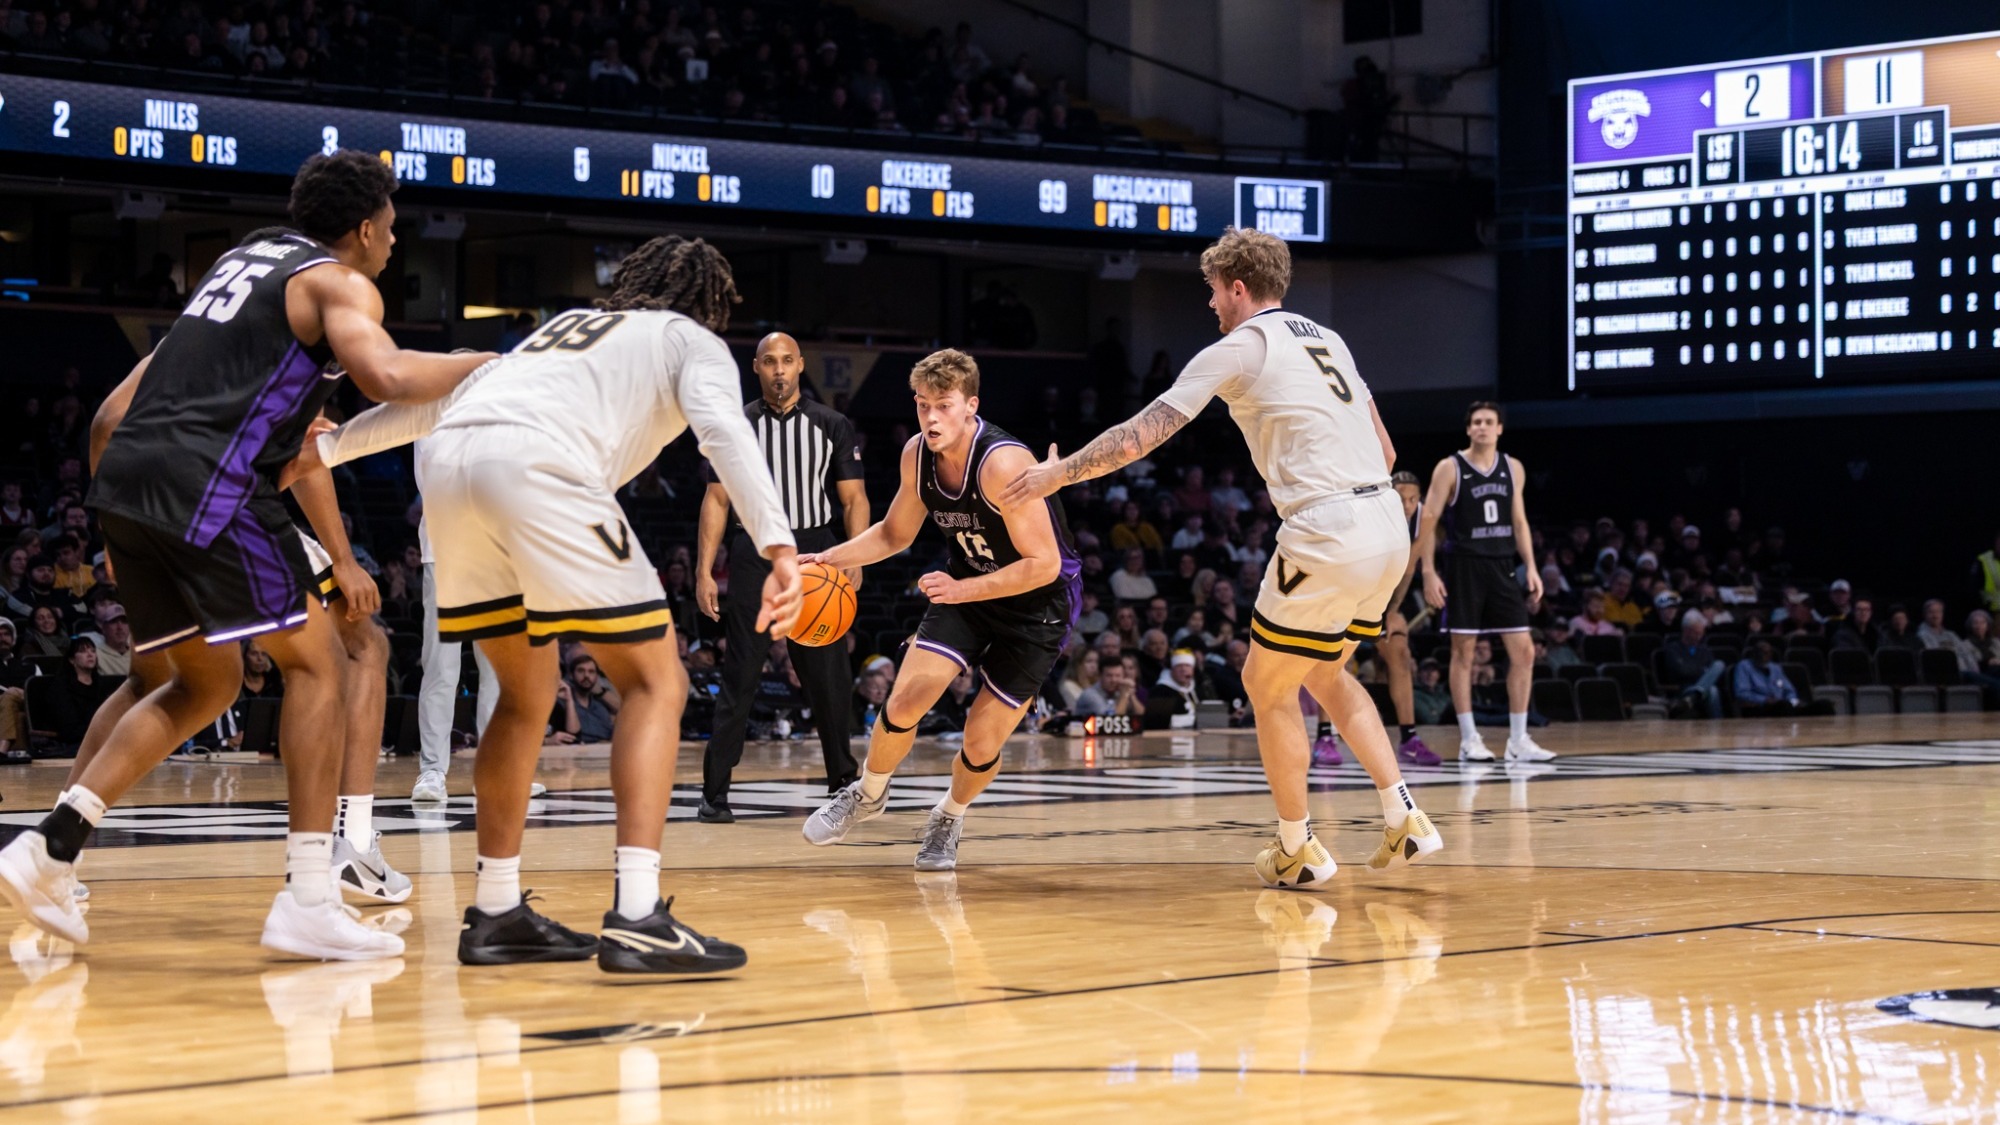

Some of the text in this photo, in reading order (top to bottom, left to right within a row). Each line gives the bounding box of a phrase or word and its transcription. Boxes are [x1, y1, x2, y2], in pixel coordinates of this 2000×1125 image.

[1745, 74, 1760, 117] 2
[1876, 59, 1891, 104] 11
[53, 101, 70, 138] 2
[145, 99, 199, 132] MILES
[114, 127, 237, 165] 0 PTS 0 FLS
[322, 126, 338, 157] 3
[401, 123, 466, 155] TANNER
[1707, 134, 1733, 161] 1ST
[1781, 121, 1861, 176] 16:14
[1914, 119, 1934, 146] 15
[395, 151, 427, 181] PTS
[452, 156, 465, 184] 0
[467, 157, 496, 187] FLS
[574, 147, 590, 182] 5
[652, 143, 710, 173] NICKEL
[621, 169, 740, 203] 11 PTS 0 FLS
[811, 164, 834, 199] 10
[882, 160, 951, 190] OKEREKE
[1093, 174, 1192, 206] MCGLOCKTON
[866, 186, 974, 218] 0 PTS 0 FLS
[1039, 180, 1067, 214] 99
[1253, 184, 1307, 211] ON THE
[1094, 200, 1197, 232] 0 PTS 0 FLS
[1256, 210, 1304, 237] FLOOR
[183, 259, 275, 324] 25
[1967, 293, 1977, 312] 2
[520, 313, 627, 353] 99
[1283, 320, 1324, 340] NICKEL
[1303, 344, 1354, 405] 5
[1471, 483, 1508, 498] CENTRAL
[1483, 500, 1499, 524] 0
[586, 518, 631, 562] V
[956, 530, 994, 561] 12
[1471, 525, 1512, 539] ARKANSAS
[1277, 551, 1313, 598] V
